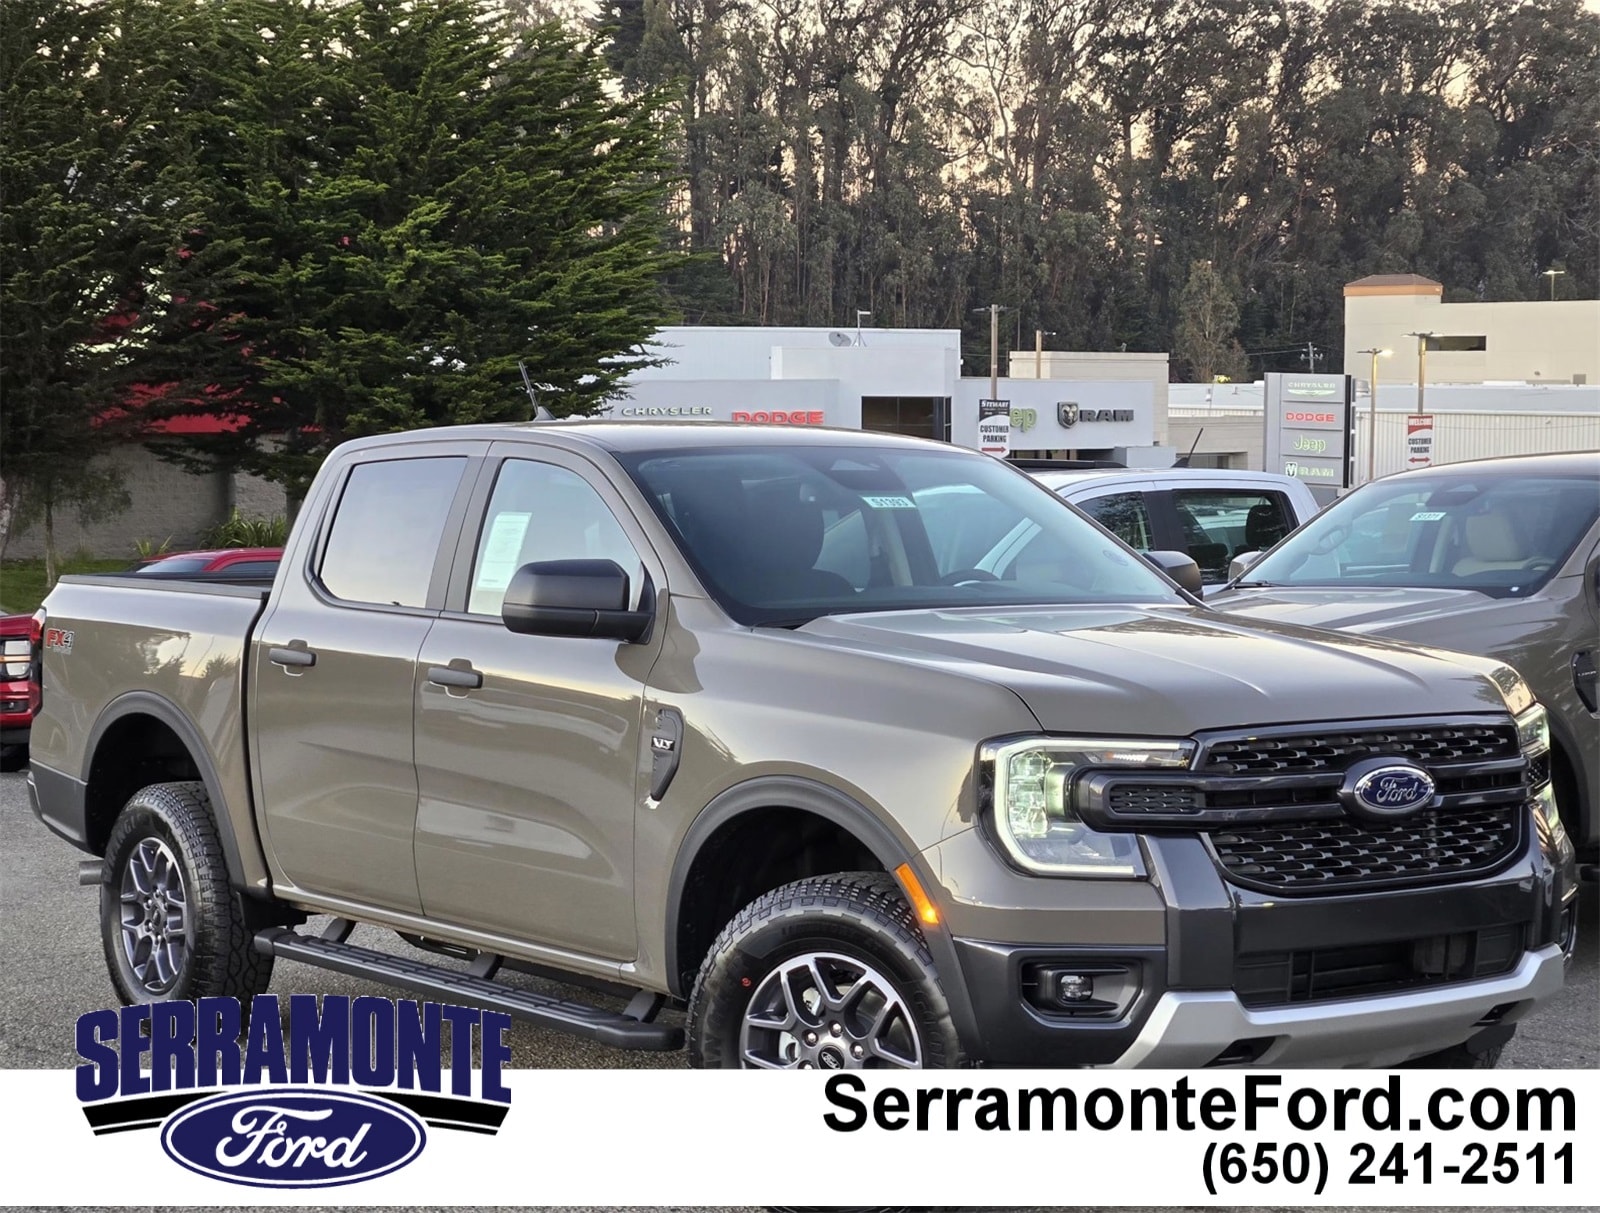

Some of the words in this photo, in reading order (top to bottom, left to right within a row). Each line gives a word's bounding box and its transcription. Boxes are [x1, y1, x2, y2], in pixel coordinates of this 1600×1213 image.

[621, 406, 713, 416] CHRYSLER
[732, 411, 824, 424] DODGE
[1079, 409, 1134, 422] RAM
[1286, 412, 1335, 422] DODGE
[1010, 407, 1037, 432] ep
[980, 425, 1009, 433] CUSTOMER
[983, 434, 1007, 443] PARKING
[1293, 435, 1326, 453] Jeep
[1299, 467, 1334, 477] RAM
[46, 628, 74, 648] FX4
[1376, 776, 1419, 803] Ford
